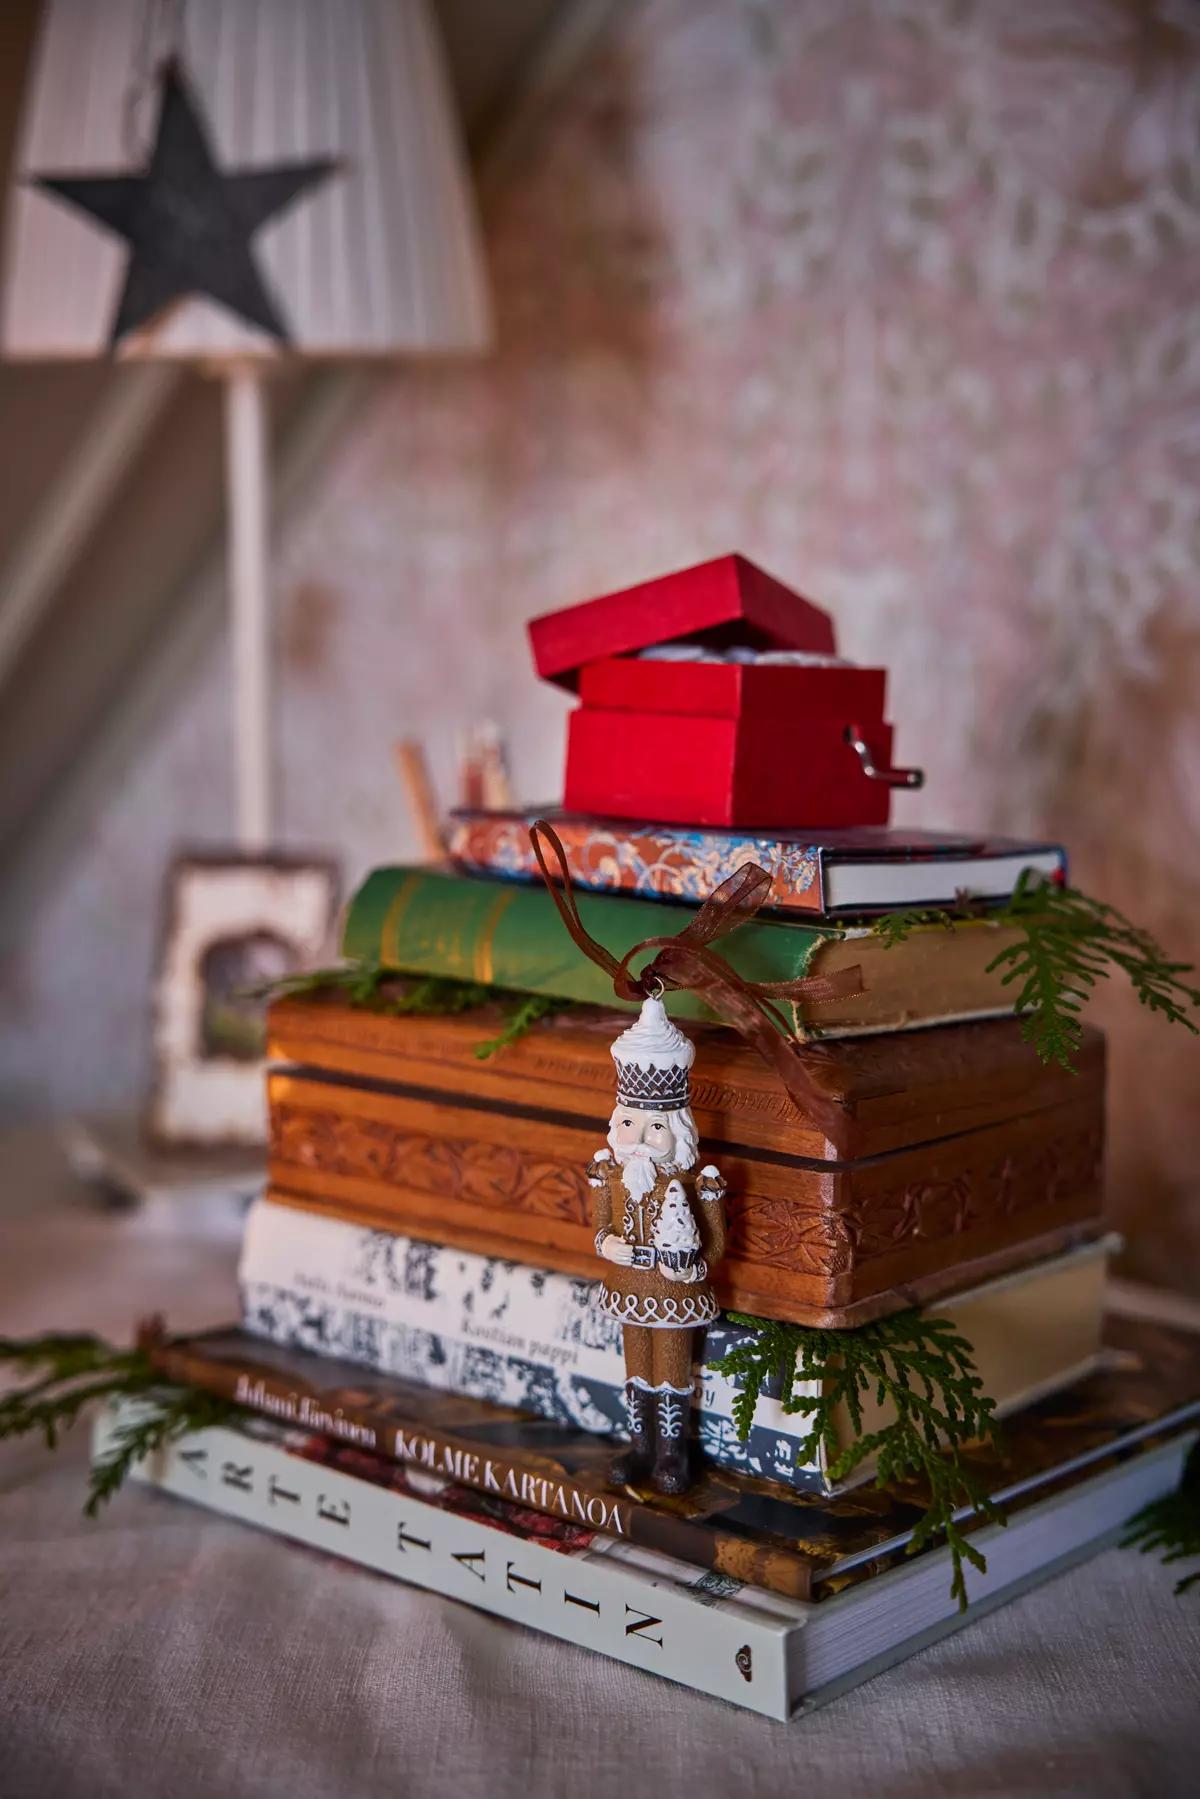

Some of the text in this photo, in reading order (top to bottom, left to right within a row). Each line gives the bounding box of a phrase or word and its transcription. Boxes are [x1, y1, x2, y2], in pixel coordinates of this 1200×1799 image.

[177, 1449, 664, 1650] ARTE TATIN
[395, 1429, 624, 1535] KOLME KARTANOA
